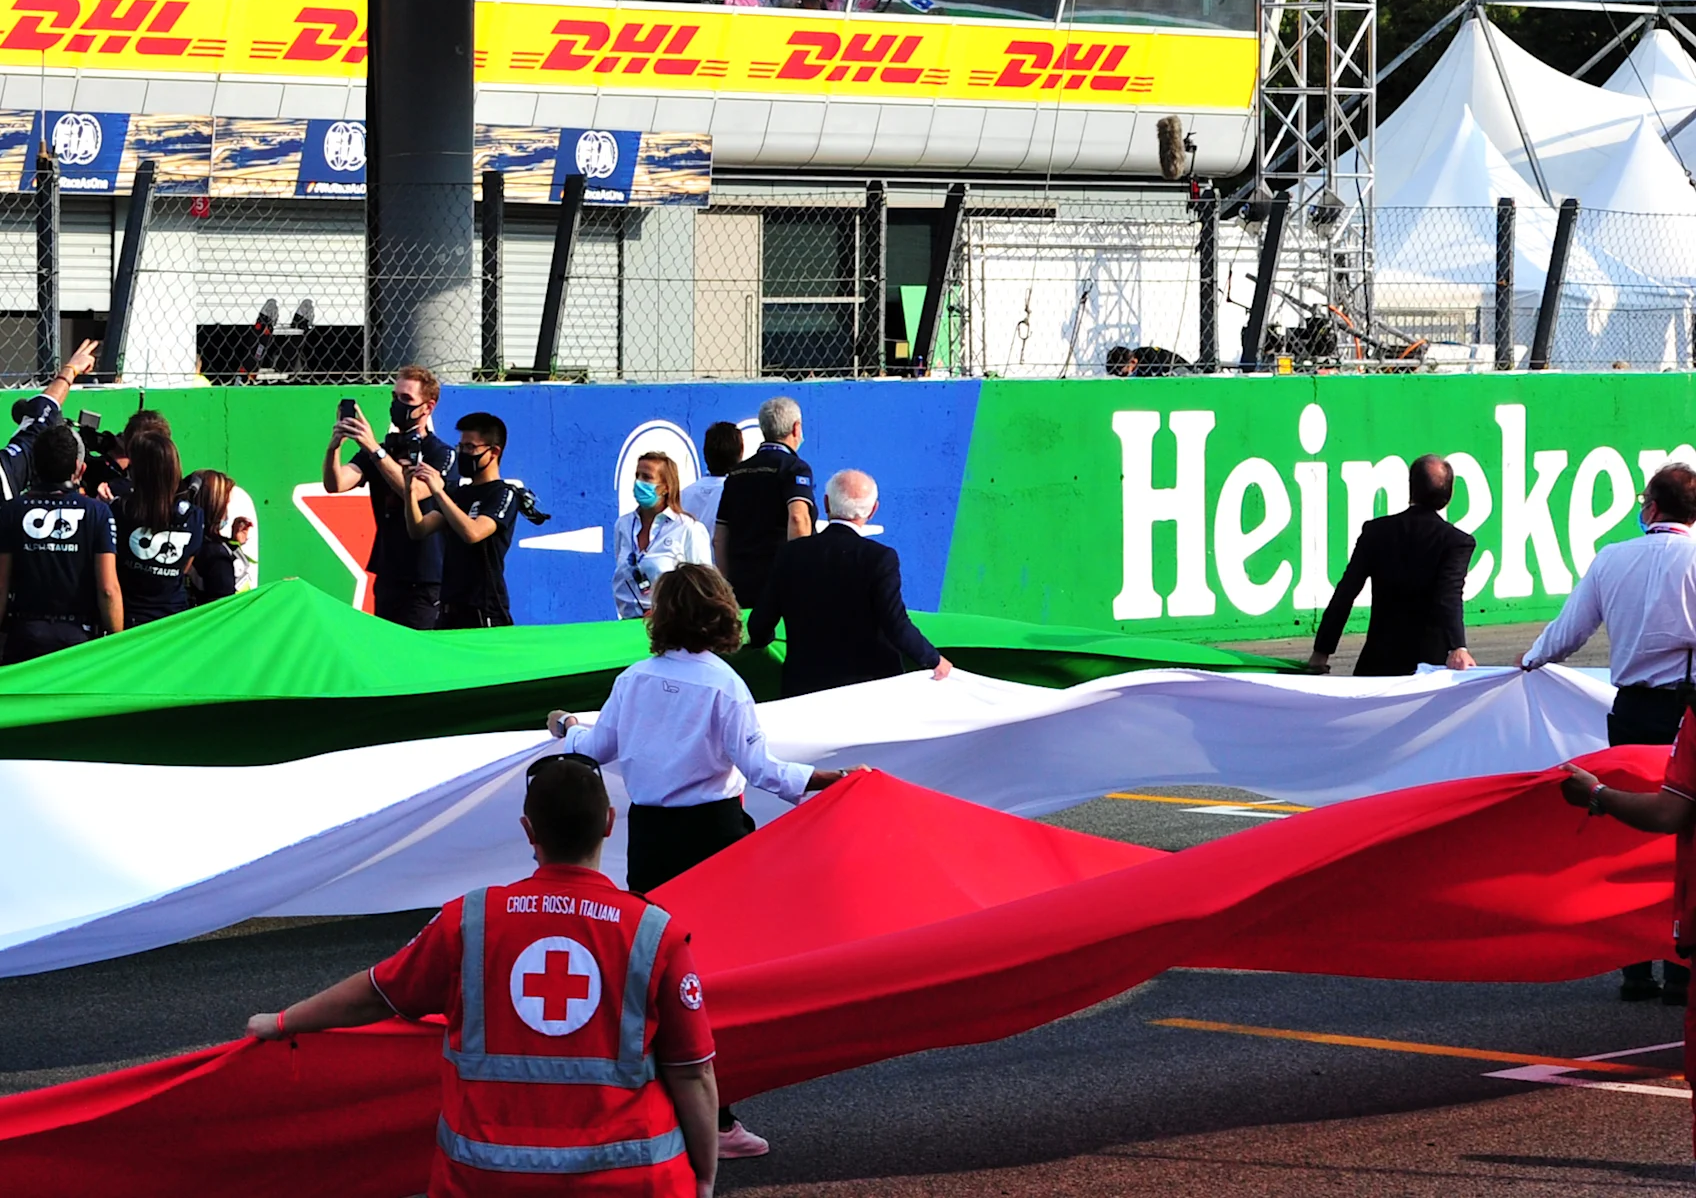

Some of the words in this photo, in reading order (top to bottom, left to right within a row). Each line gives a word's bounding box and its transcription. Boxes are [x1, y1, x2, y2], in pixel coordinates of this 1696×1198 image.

[540, 19, 703, 76] DHL
[774, 30, 924, 84] DHL
[994, 40, 1131, 92] DHL
[54, 119, 101, 159] FIA
[1112, 402, 1696, 621] Heineke
[23, 543, 79, 552] ALPHATAURI
[507, 896, 539, 913] CROCE
[542, 895, 575, 915] ROSSA
[579, 899, 621, 923] ITALIANA
